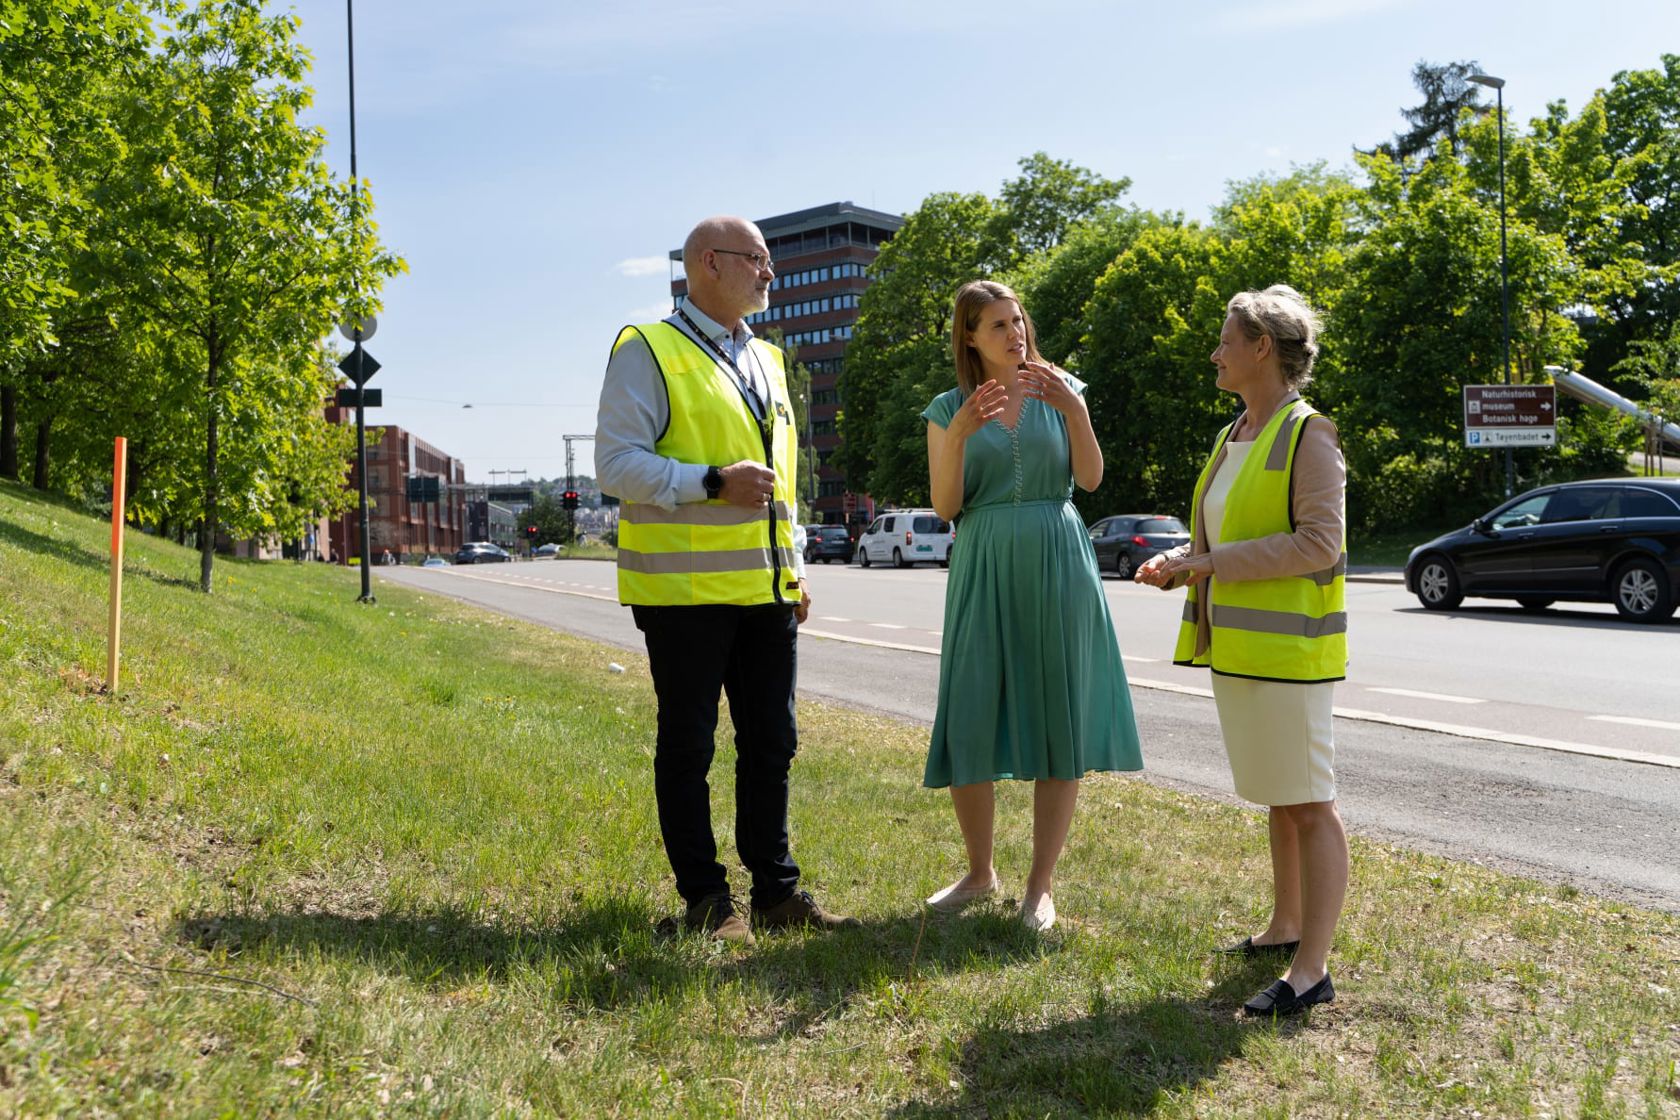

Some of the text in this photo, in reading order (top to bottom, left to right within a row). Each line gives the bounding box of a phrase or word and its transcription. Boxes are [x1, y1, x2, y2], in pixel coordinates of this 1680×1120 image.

[1482, 390, 1536, 398] Naturhistorisk
[1482, 414, 1538, 424] Botanisk hage
[1496, 432, 1538, 442] Tøyenbadet
